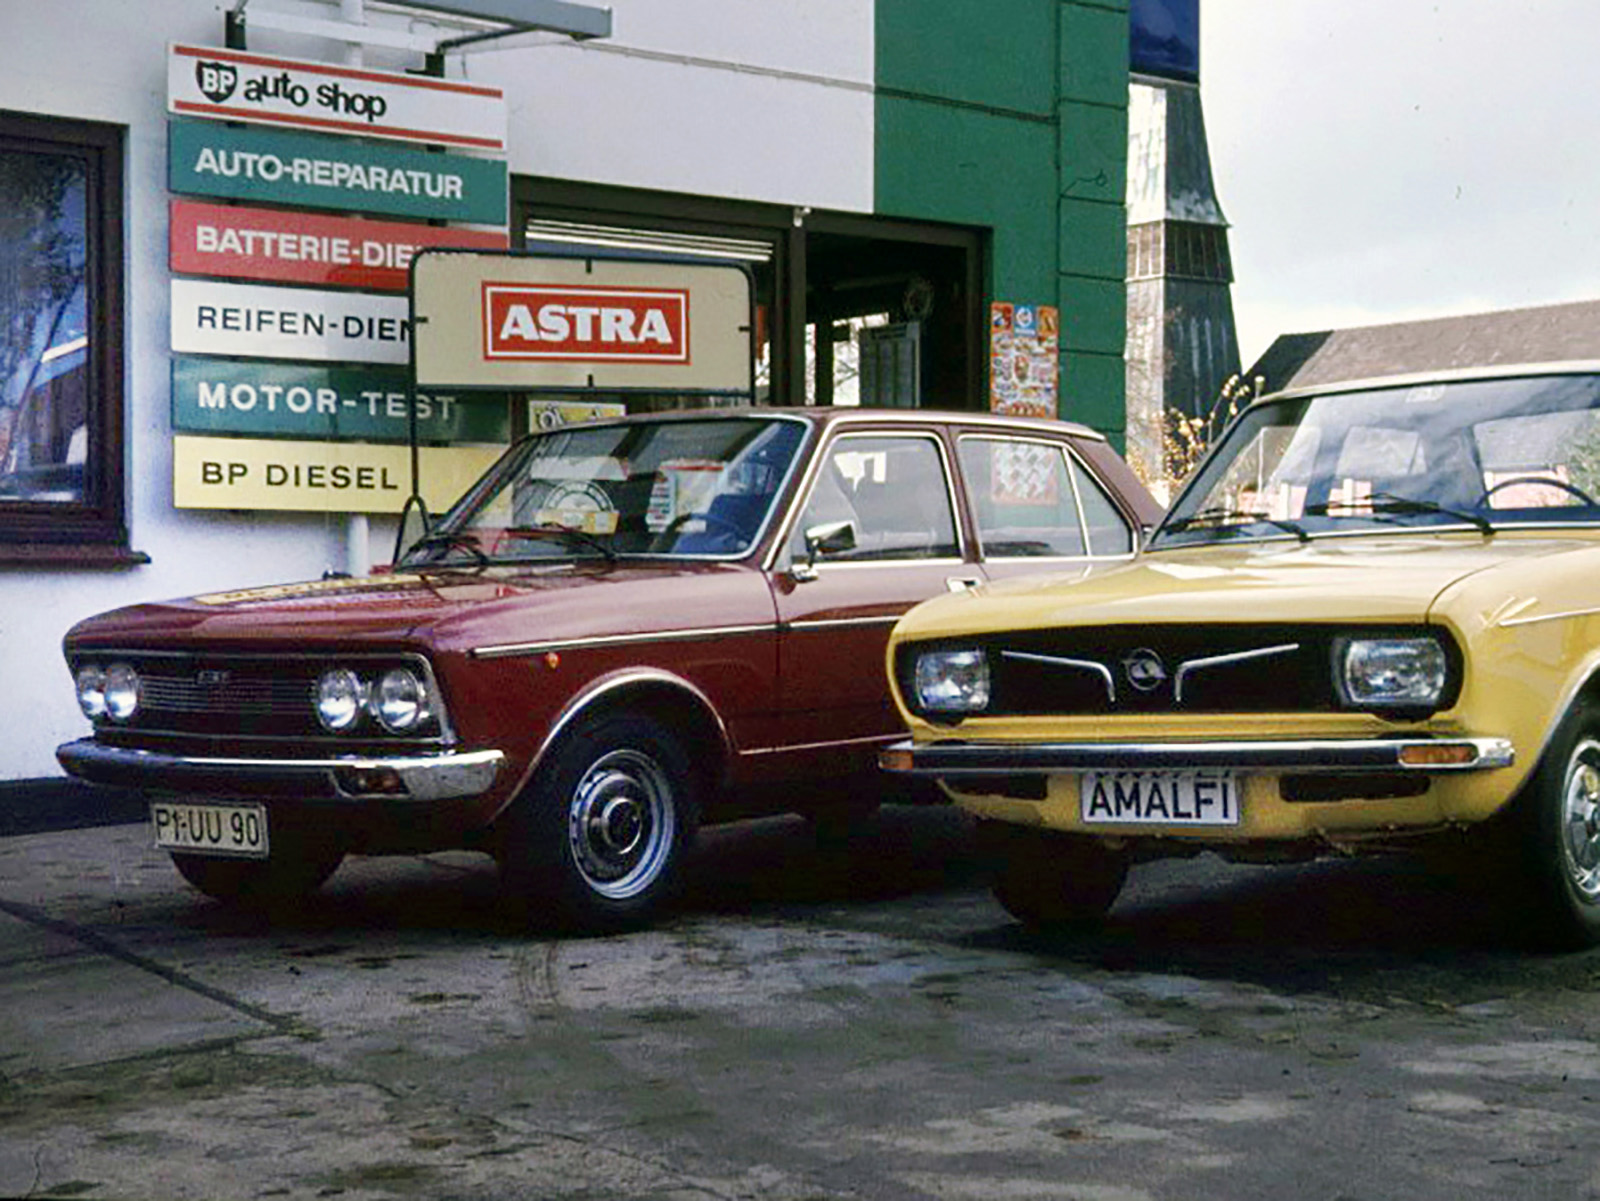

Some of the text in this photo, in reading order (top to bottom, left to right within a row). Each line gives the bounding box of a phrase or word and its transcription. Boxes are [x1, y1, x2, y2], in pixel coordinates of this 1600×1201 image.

[244, 72, 309, 107] auto
[316, 83, 387, 122] shop
[195, 148, 463, 200] AUTO-REPARATUR
[196, 225, 422, 270] BATTERIE-DIE
[500, 304, 673, 344] ASTRA
[198, 382, 456, 420] MOTOR-TEST
[202, 462, 398, 490] BP DIESEL
[1088, 779, 1230, 819] AMALFI
[231, 811, 260, 846] 90
